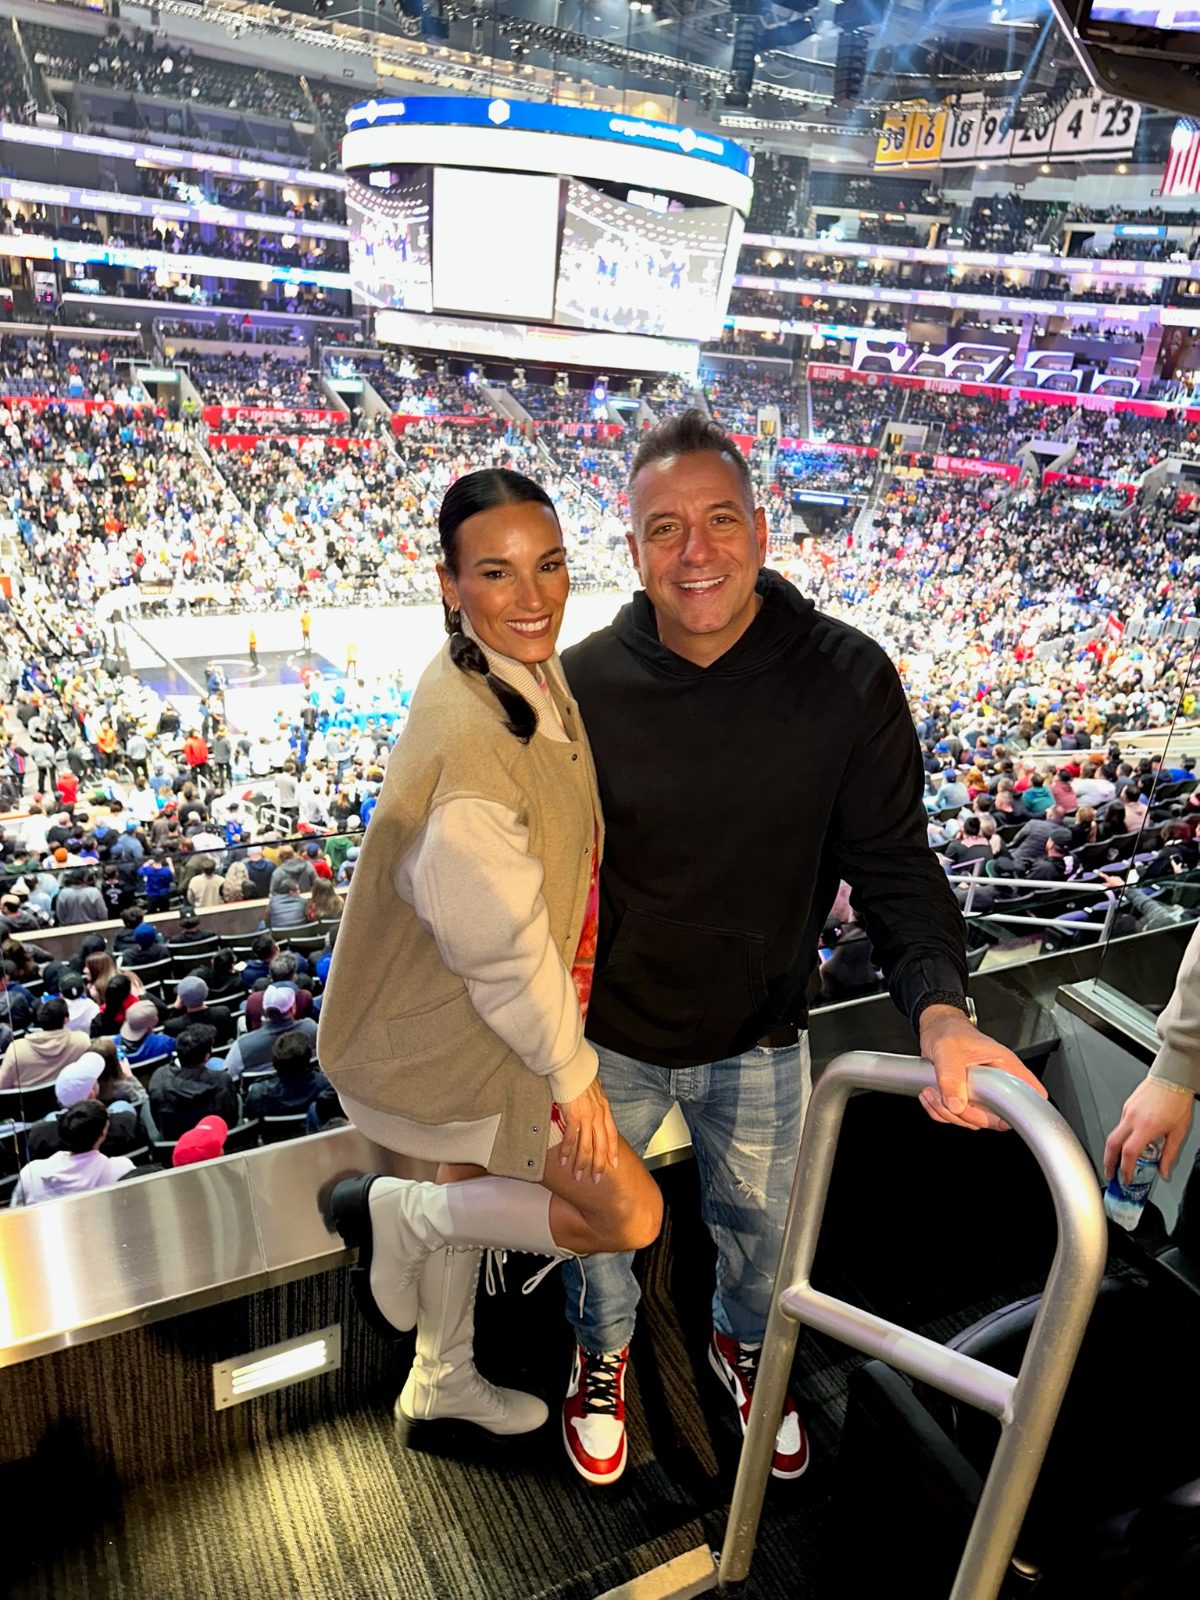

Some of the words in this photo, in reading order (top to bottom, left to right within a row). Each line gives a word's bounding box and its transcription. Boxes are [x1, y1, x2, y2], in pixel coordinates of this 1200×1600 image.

[950, 118, 972, 147] 18
[985, 116, 1012, 145] 99
[1067, 109, 1083, 138] 4
[1102, 105, 1133, 137] 23
[916, 123, 935, 149] 16
[110, 893, 119, 905] 2
